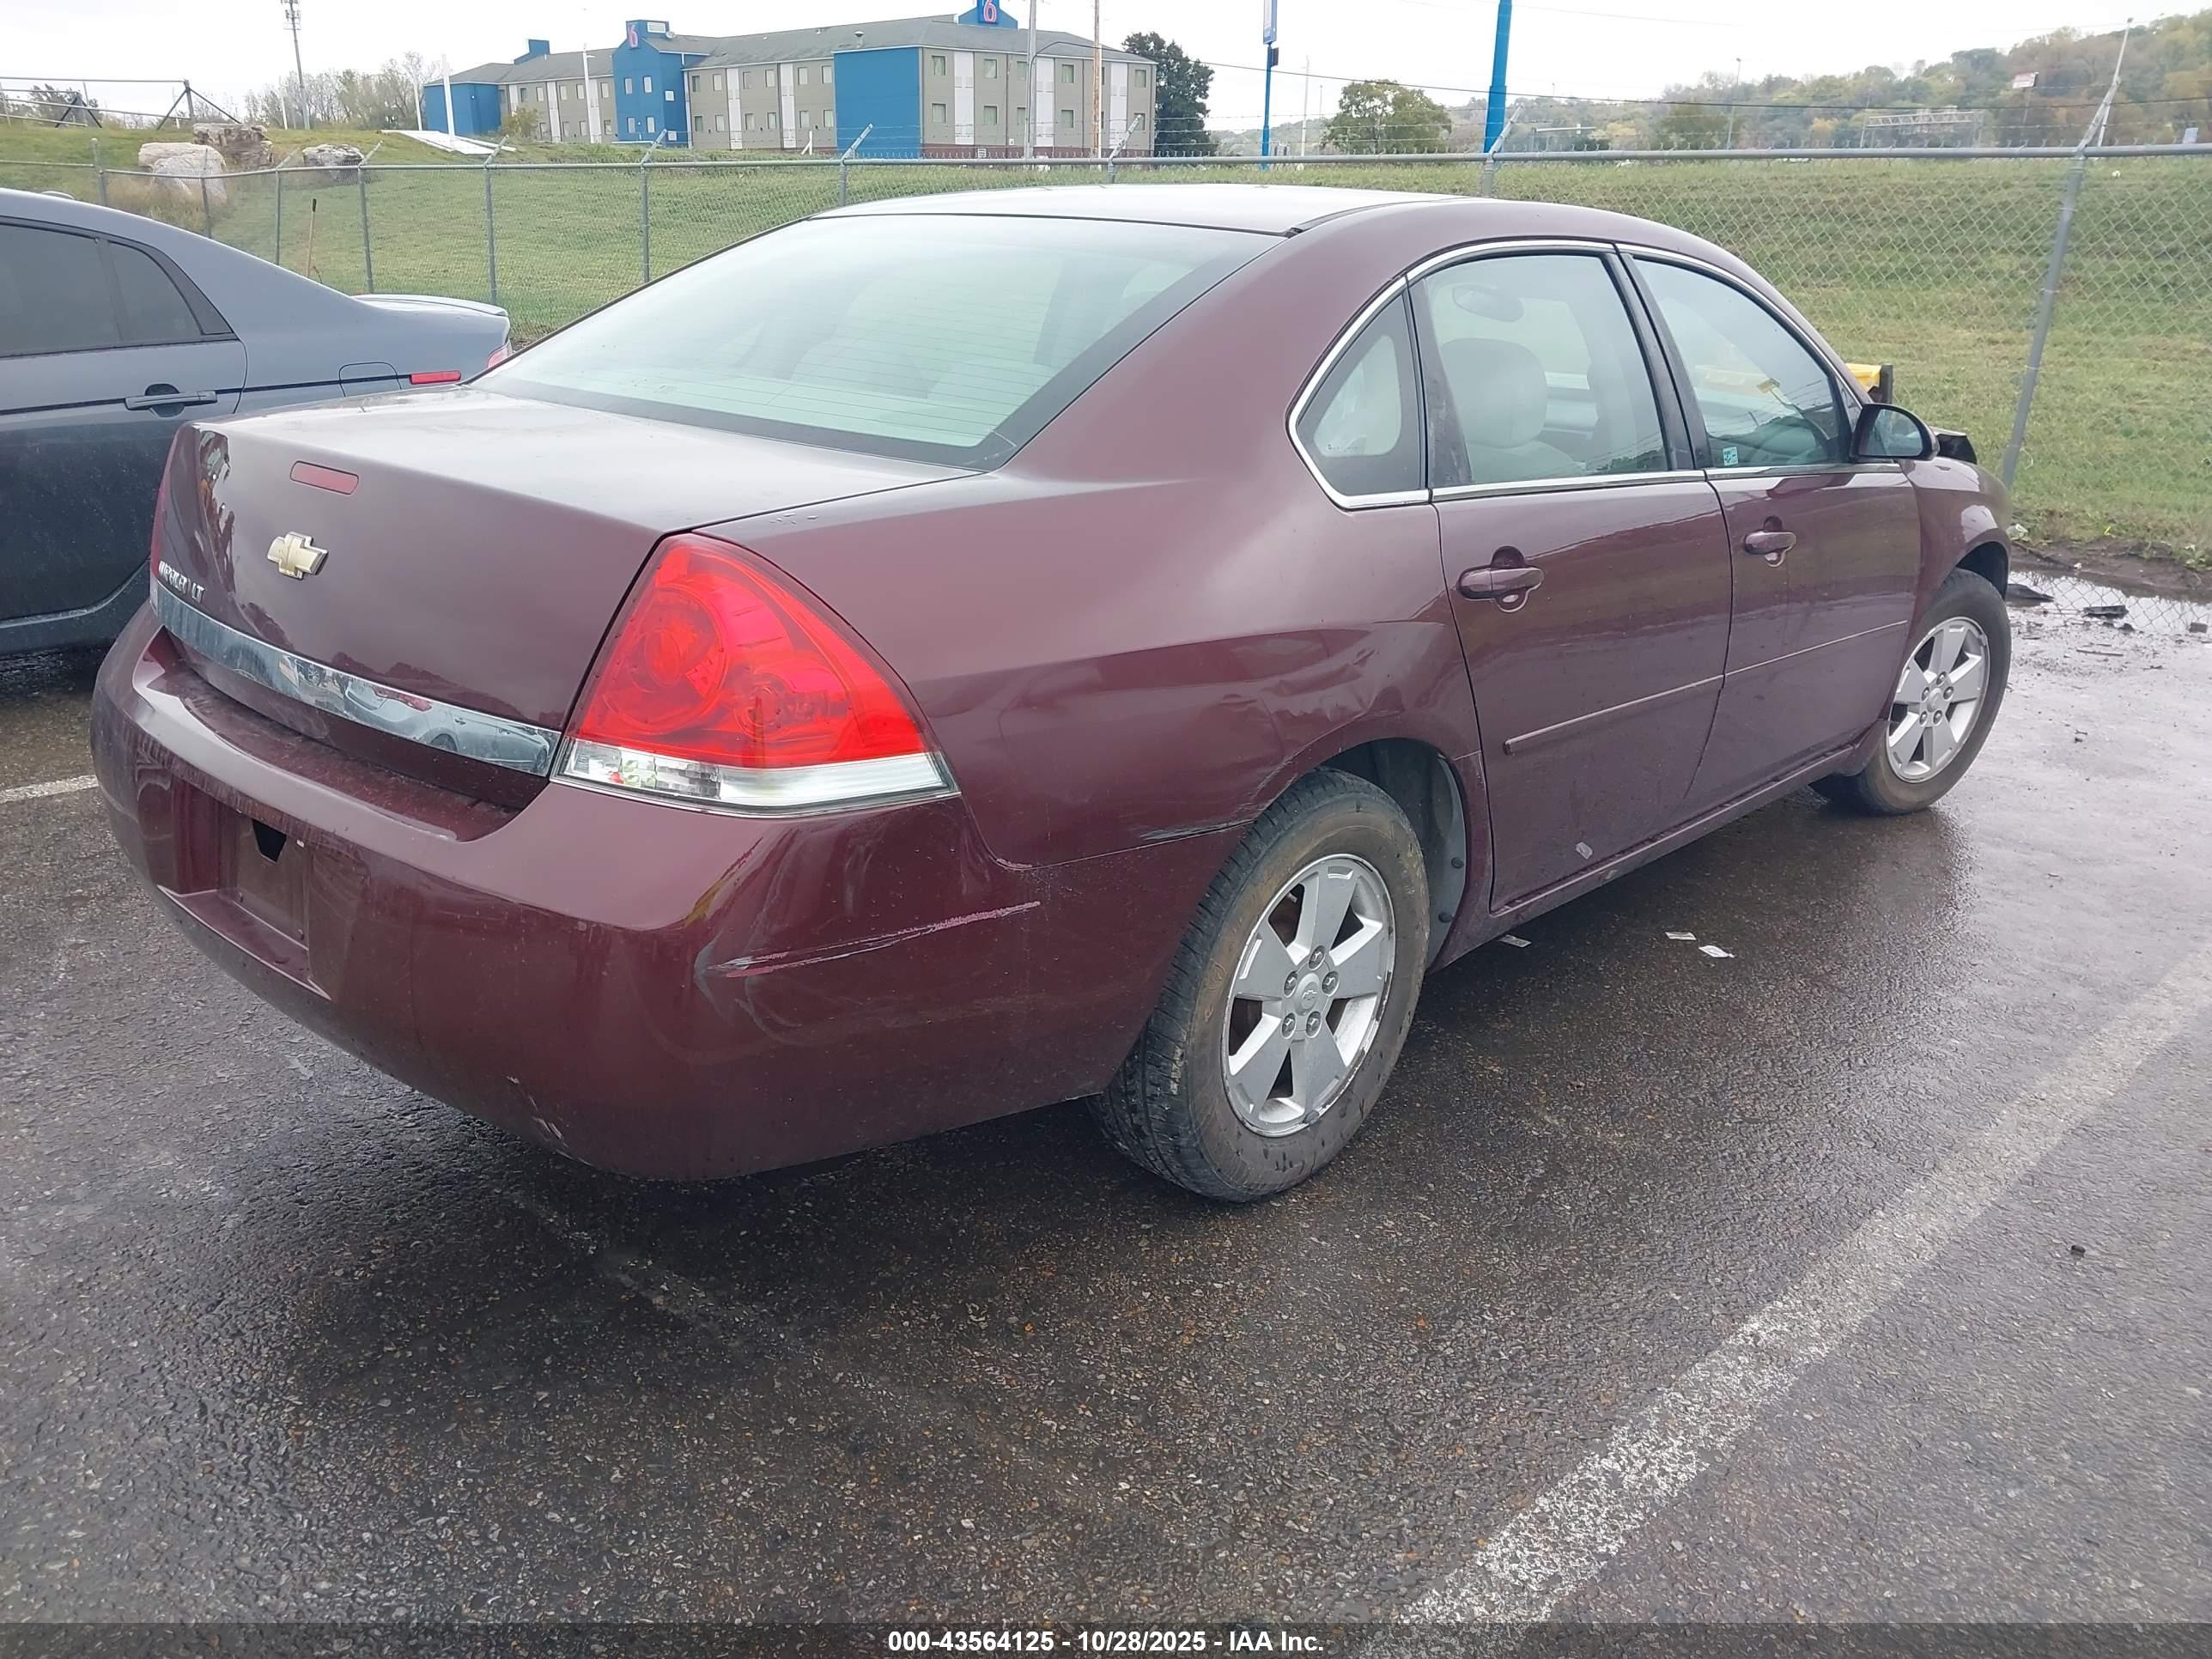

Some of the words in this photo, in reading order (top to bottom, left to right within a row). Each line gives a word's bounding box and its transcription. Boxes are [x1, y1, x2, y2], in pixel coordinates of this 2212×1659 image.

[983, 0, 997, 22] 6
[627, 24, 639, 48] 6
[191, 582, 206, 604] LT
